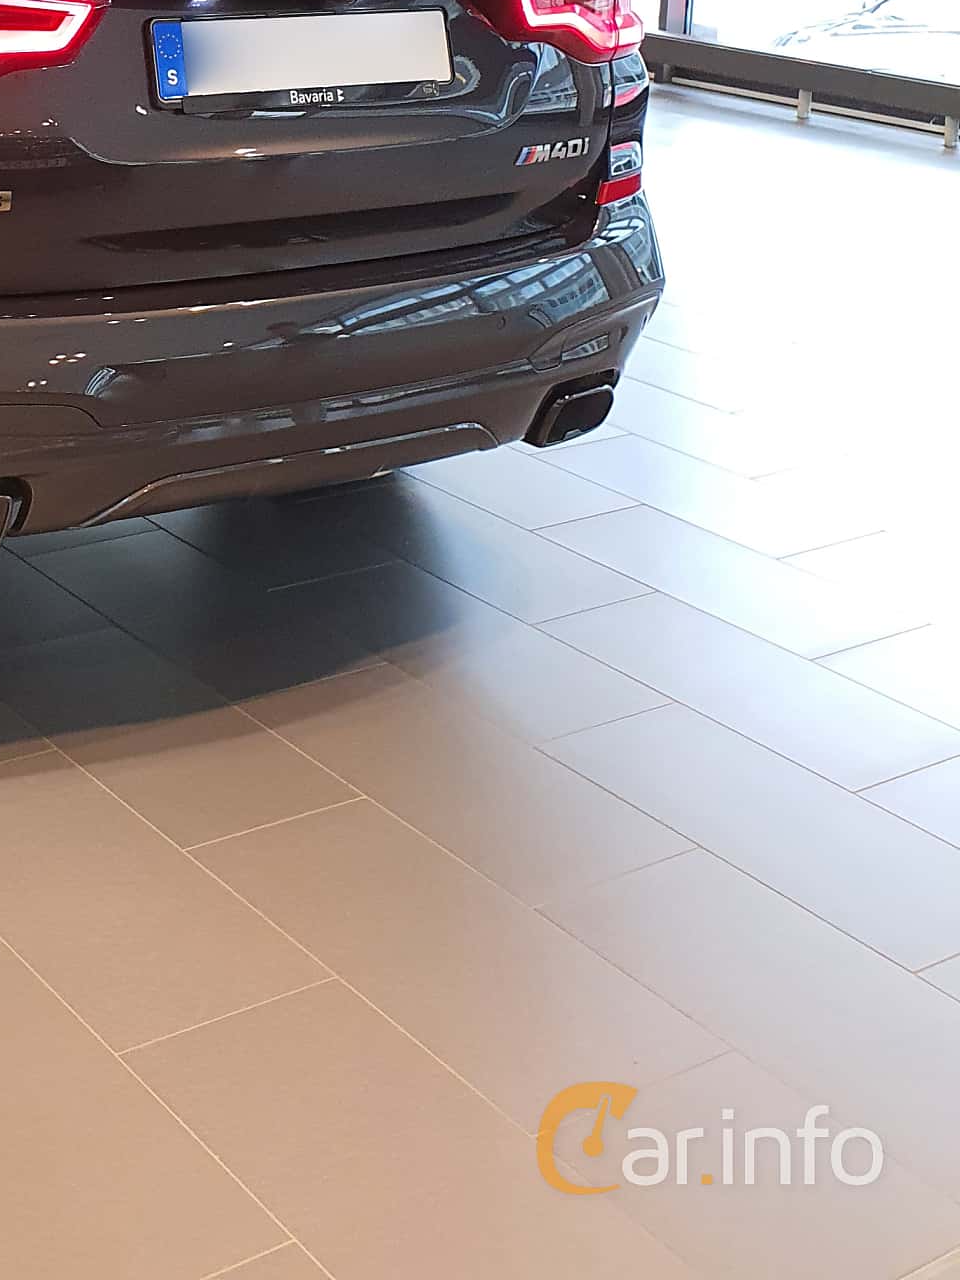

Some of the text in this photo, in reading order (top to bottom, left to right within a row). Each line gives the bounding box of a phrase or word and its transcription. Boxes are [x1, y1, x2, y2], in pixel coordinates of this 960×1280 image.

[168, 69, 178, 86] S
[290, 89, 334, 104] Bavaria
[532, 137, 590, 163] M40i
